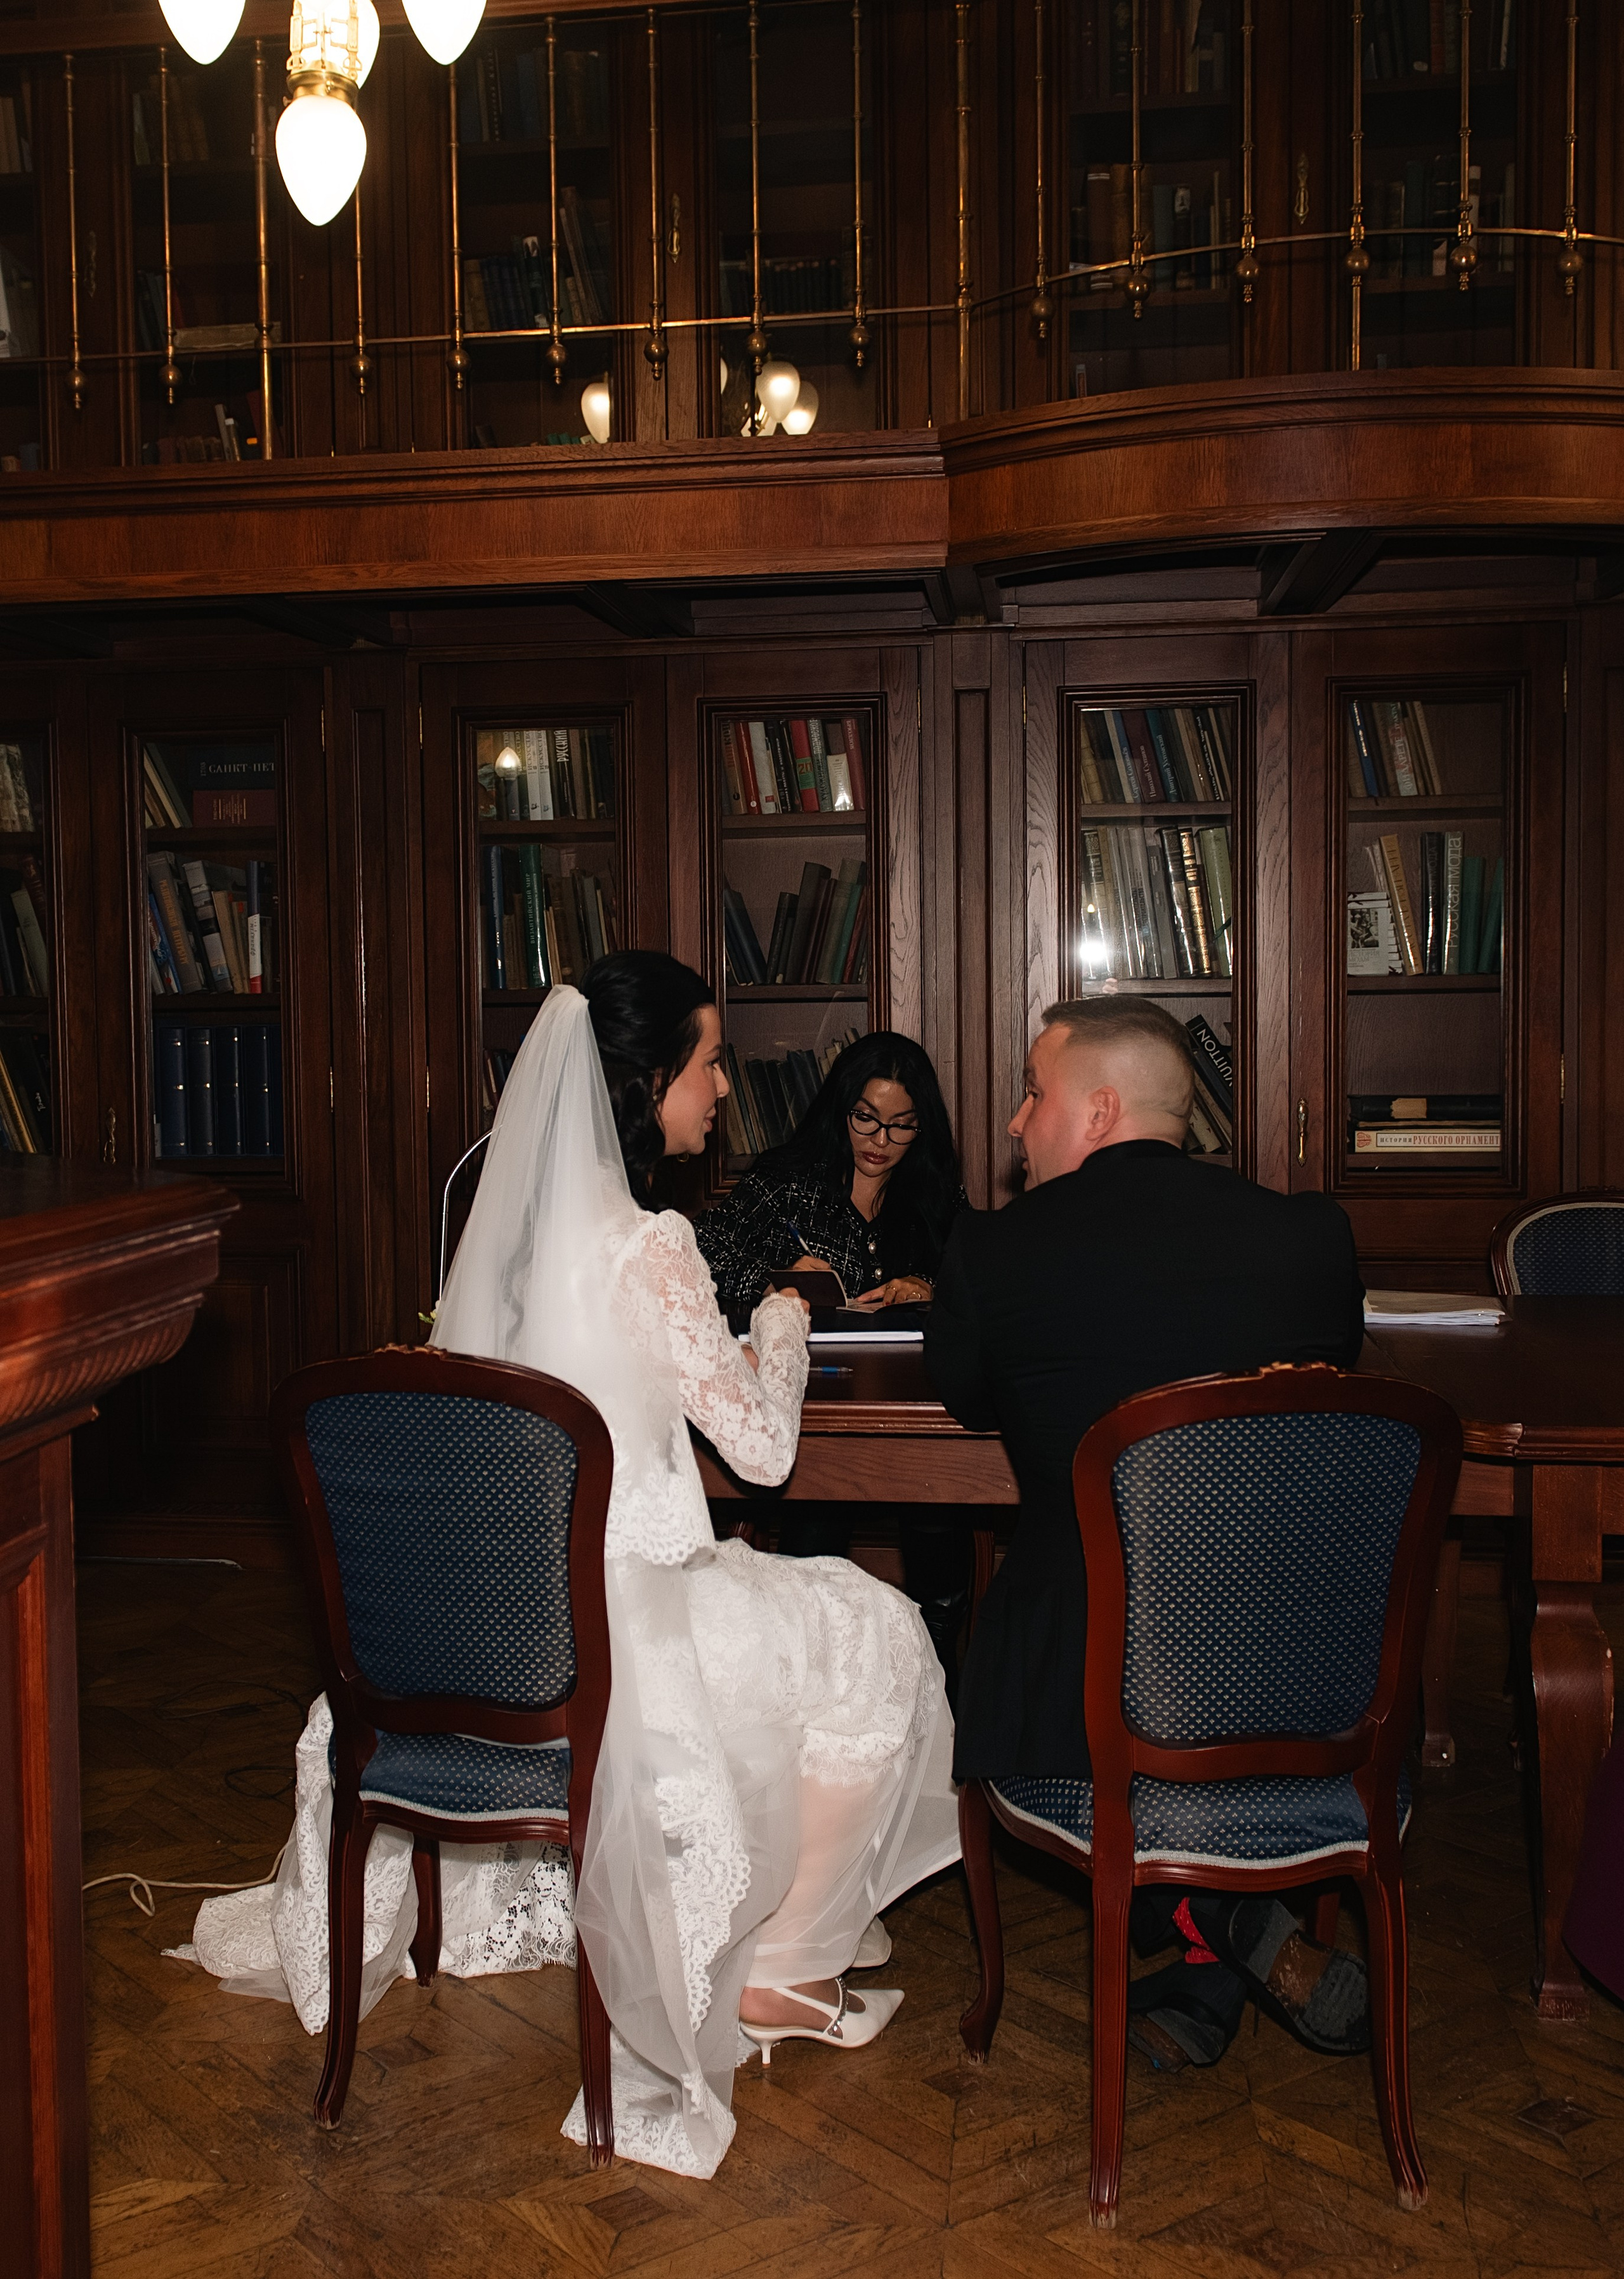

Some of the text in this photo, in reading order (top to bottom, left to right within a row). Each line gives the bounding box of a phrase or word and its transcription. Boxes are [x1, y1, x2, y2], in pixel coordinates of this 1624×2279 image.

[554, 730, 569, 762] РУССКИЙ
[526, 890, 535, 943] ВИЗАНТИЙСКИЙ
[1413, 1135, 1453, 1145] РУССКОГО
[1455, 1135, 1500, 1145] ОРНАМЕНТ
